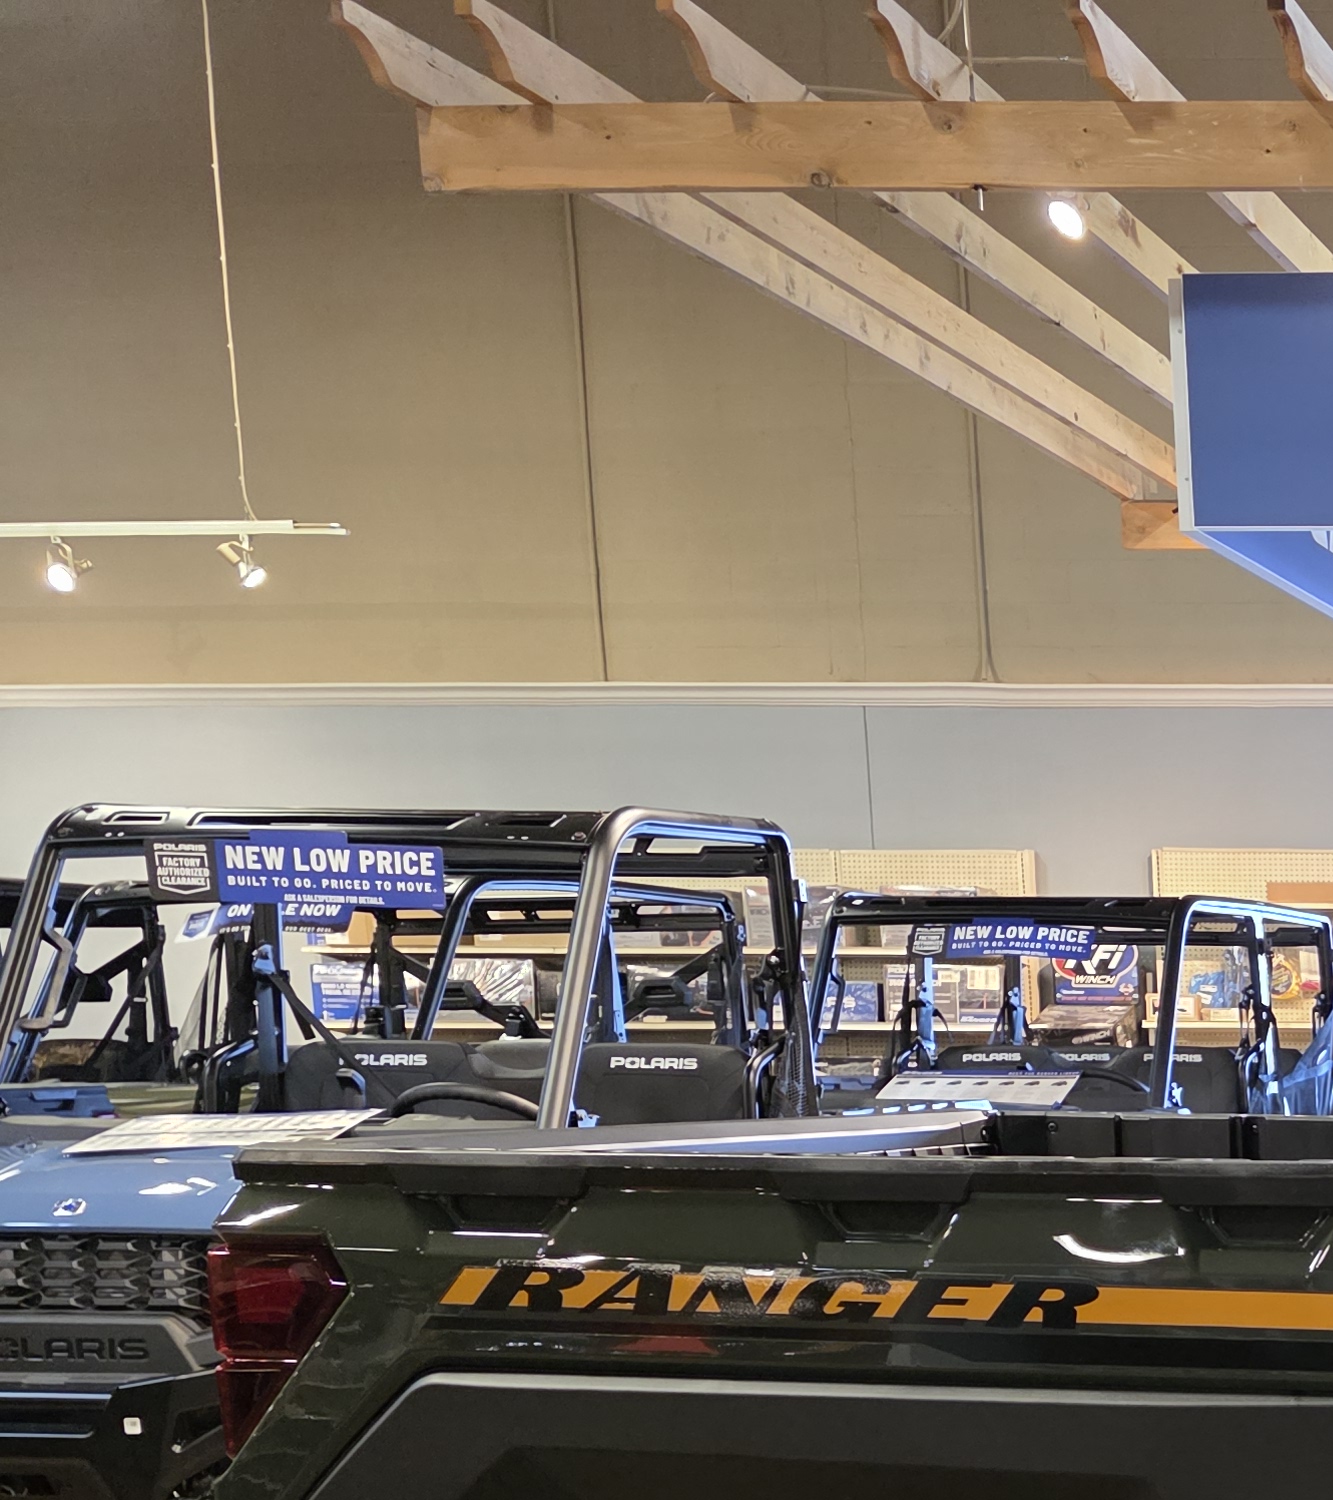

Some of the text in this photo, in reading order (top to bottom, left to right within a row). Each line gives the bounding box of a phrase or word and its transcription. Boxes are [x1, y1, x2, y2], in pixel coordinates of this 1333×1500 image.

[162, 857, 201, 867] FACTORY
[225, 845, 436, 876] NEW LOW PRICE
[157, 867, 210, 877] AUTHORIZED
[227, 875, 438, 894] BUILT TO GO. PRICED TO MOVE.
[226, 904, 251, 918] ON
[300, 904, 341, 918] NOW
[954, 926, 1090, 944] NEW LOW PRICE
[1075, 974, 1116, 984] WINCH
[340, 1053, 428, 1067] OLARIS
[610, 1056, 699, 1070] POLARIS
[962, 1052, 1022, 1062] POLARIS
[1143, 1053, 1203, 1063] PARIS
[477, 1258, 1103, 1331] RANGER
[0, 1337, 149, 1362] OLARIS
